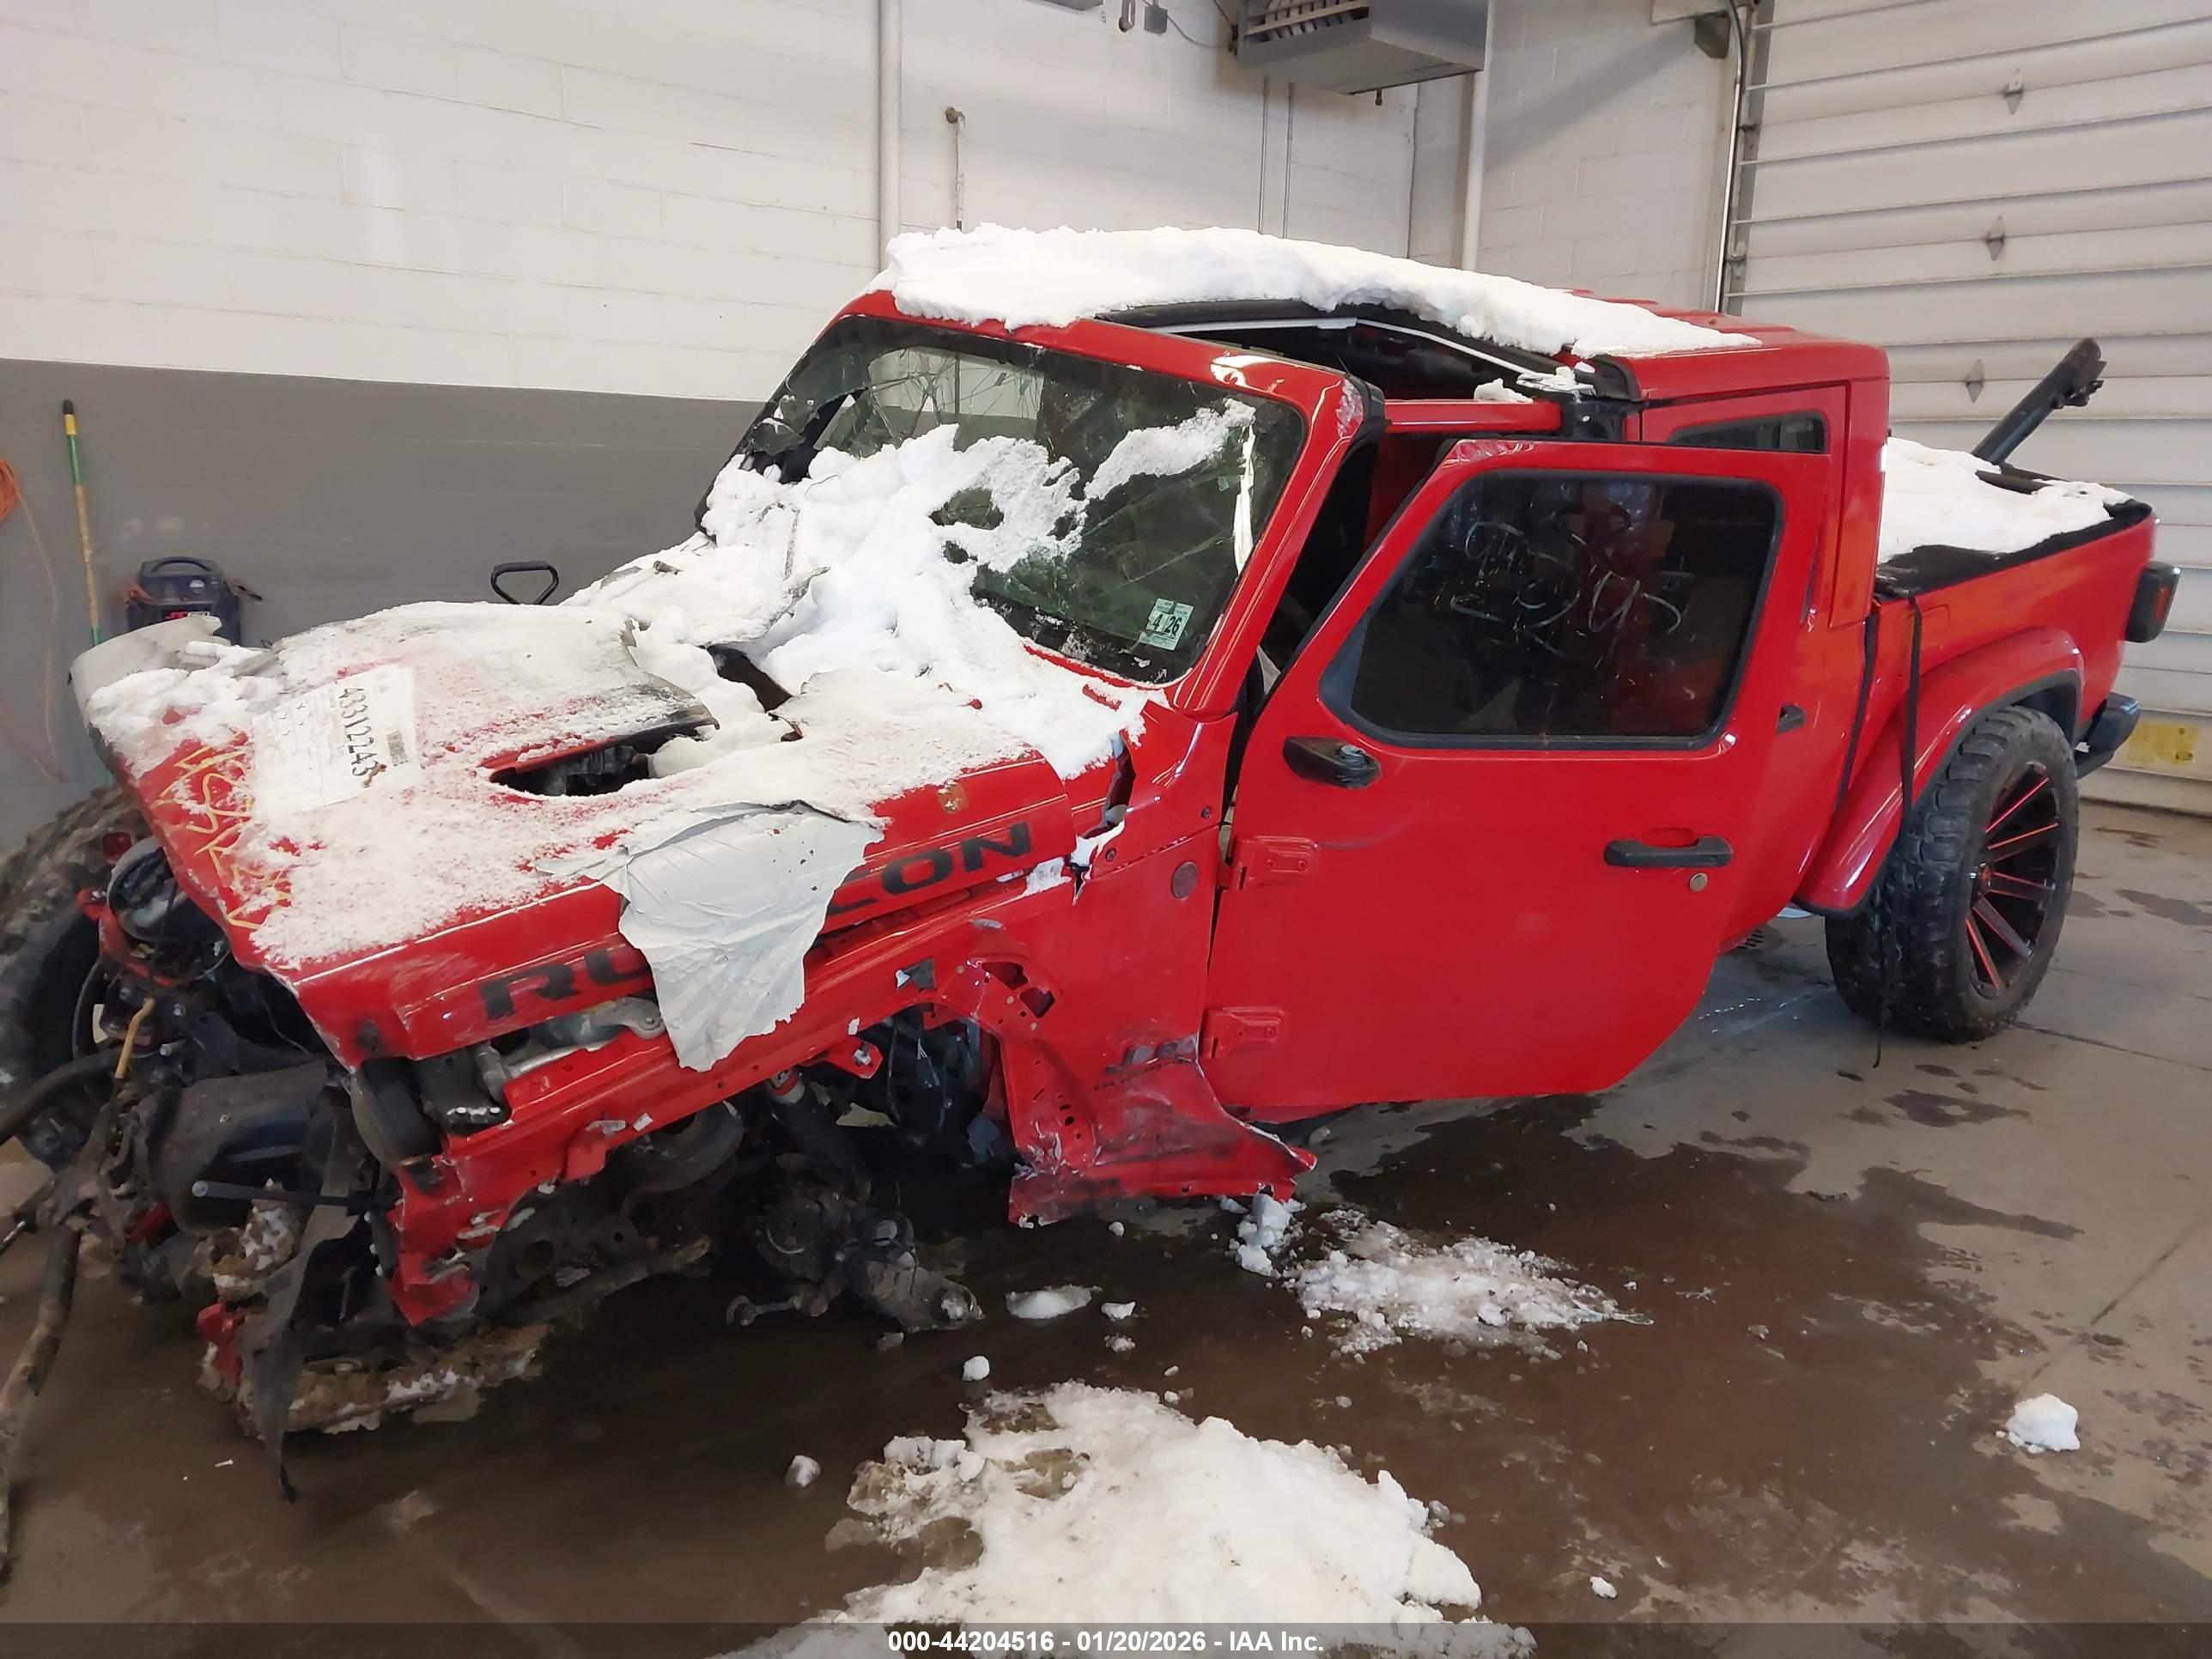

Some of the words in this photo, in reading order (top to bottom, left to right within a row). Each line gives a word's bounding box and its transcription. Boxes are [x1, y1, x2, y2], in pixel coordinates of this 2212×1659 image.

[1152, 614, 1164, 631] 4
[1164, 616, 1182, 635] 26
[338, 688, 380, 777] 43312243
